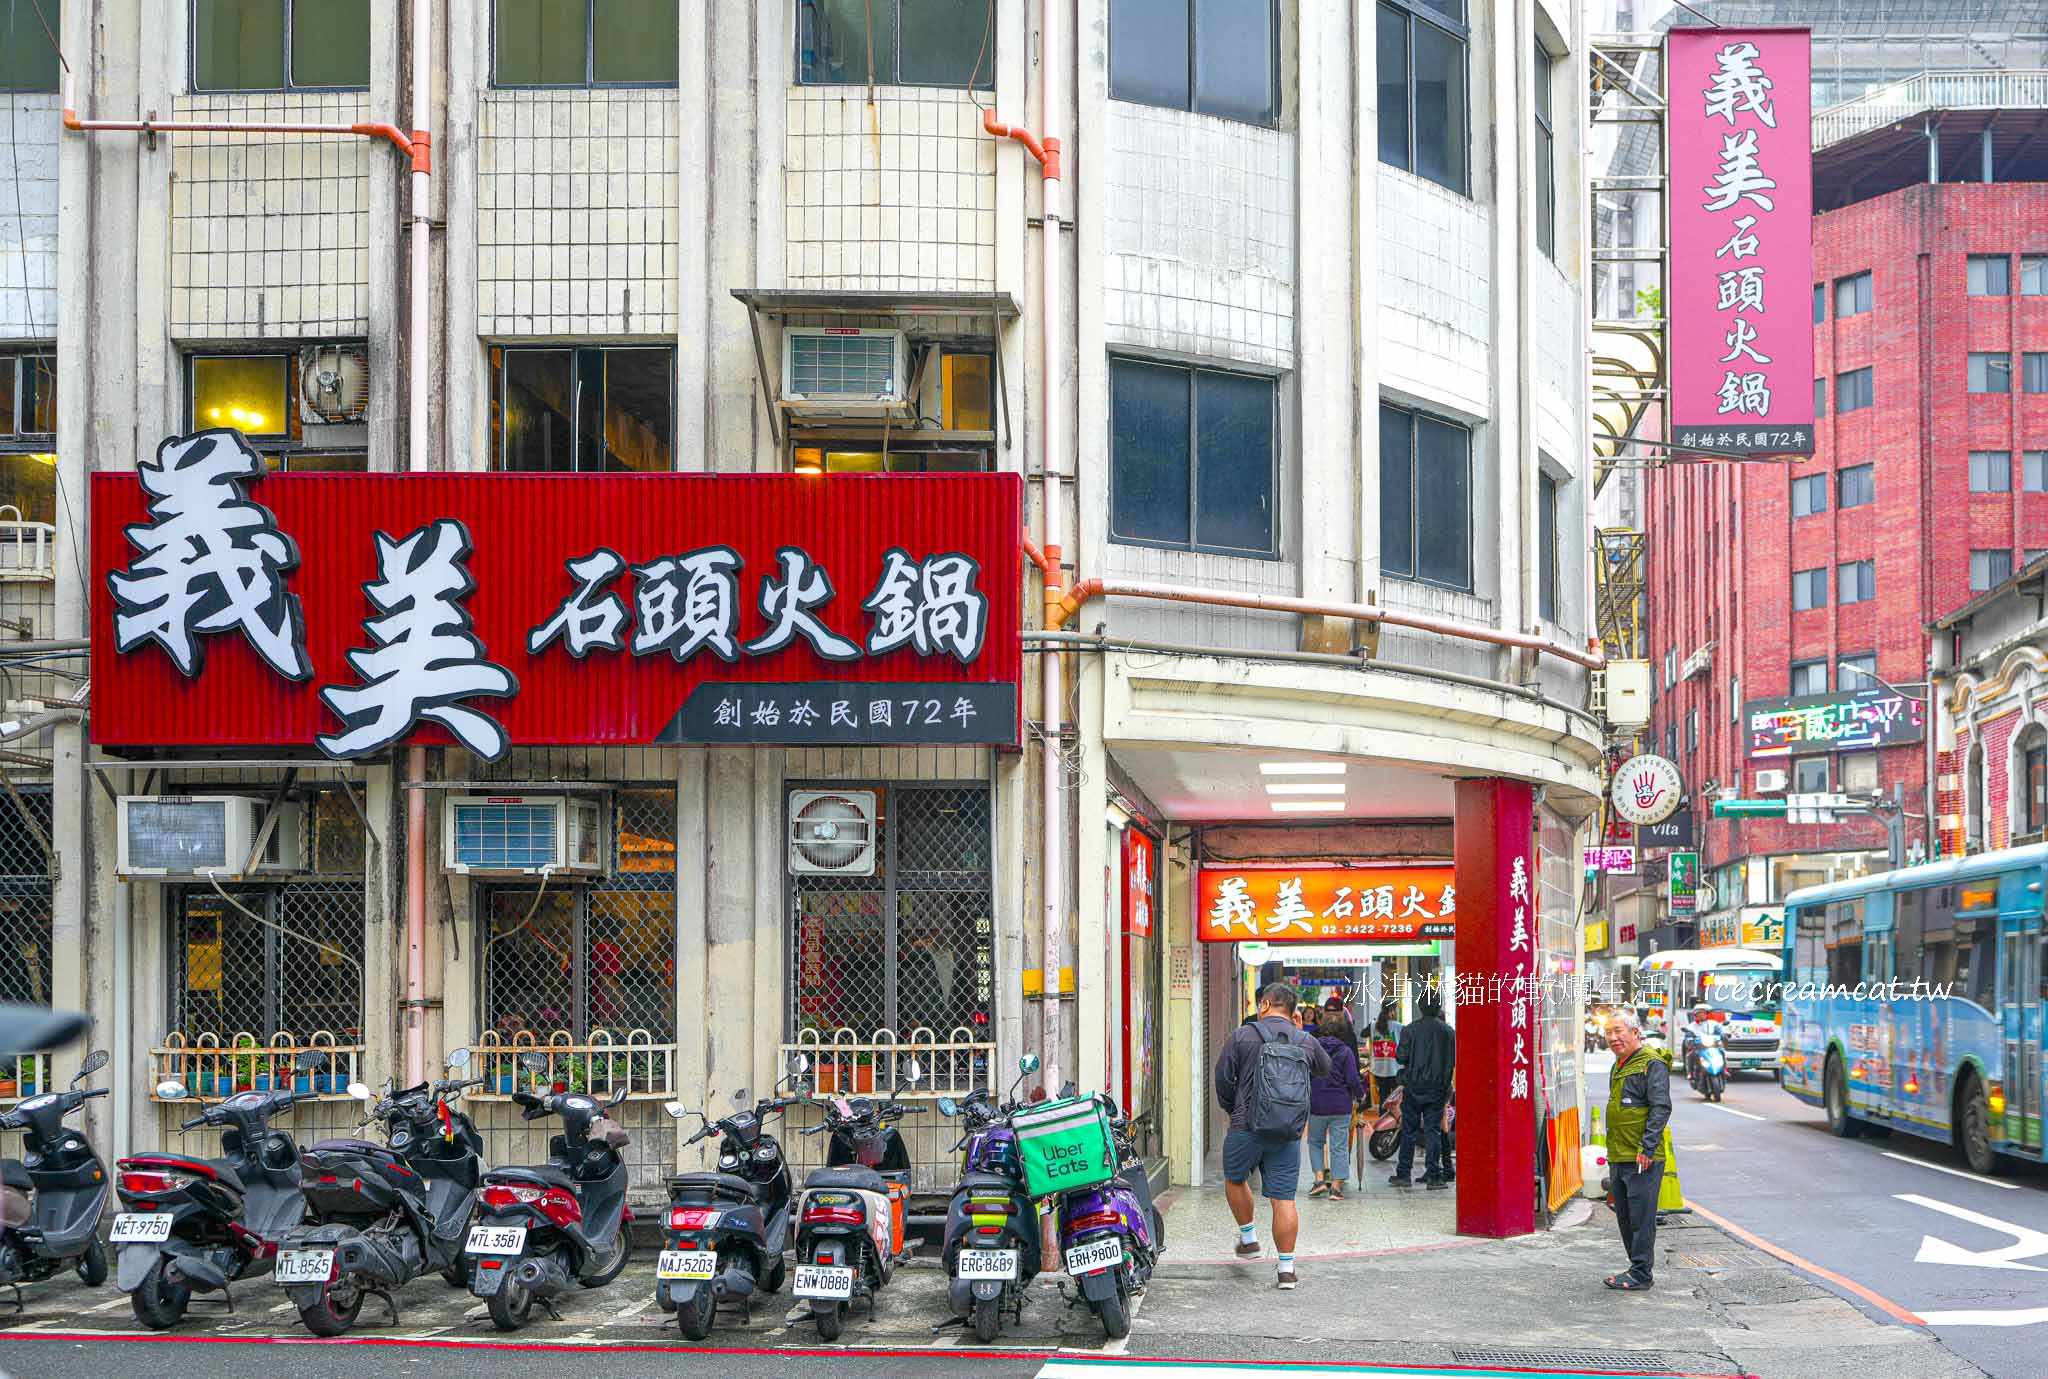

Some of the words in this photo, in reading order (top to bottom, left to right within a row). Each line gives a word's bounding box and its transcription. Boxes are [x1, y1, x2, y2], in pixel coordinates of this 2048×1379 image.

[1703, 42, 1777, 417] 義美石頭火鍋
[1681, 432, 1806, 448] 創始於民國72年
[713, 698, 978, 729] 創始於民國72年
[1043, 1142, 1084, 1161] Uber
[1047, 1159, 1089, 1178] Eats
[660, 1257, 713, 1273] NAJ-5203
[961, 1257, 1014, 1272] ERG-8689
[1069, 1245, 1119, 1269] ERH-9800
[796, 1273, 849, 1290] ENW-0888
